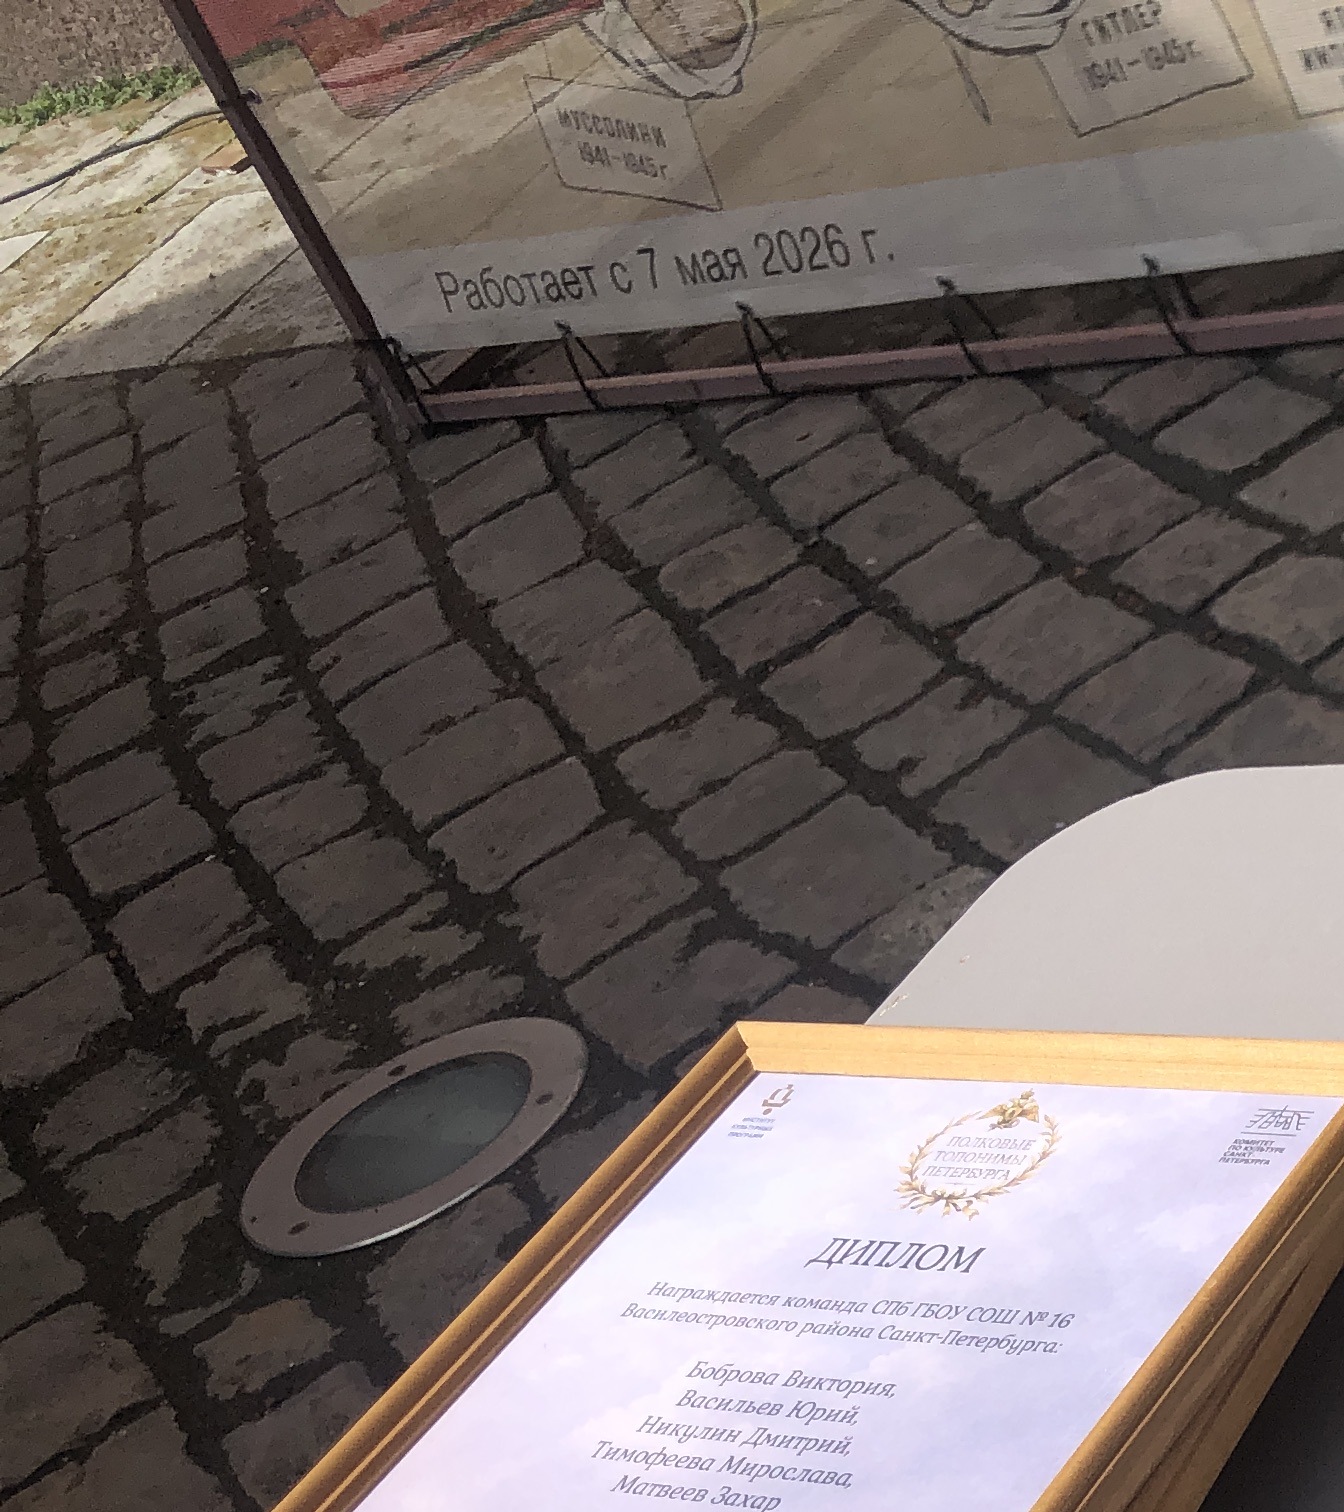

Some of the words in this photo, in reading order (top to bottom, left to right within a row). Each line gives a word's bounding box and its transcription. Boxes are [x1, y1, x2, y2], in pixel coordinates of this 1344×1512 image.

[434, 264, 599, 313] Работает
[609, 261, 633, 294] с
[636, 247, 658, 289] 7
[675, 246, 749, 287] мая
[754, 223, 851, 277] 2026
[860, 229, 895, 264] г.
[934, 1150, 1027, 1165] ТОПОНИМЫ
[946, 1136, 1036, 1150] ПОЛКОВЫЕ
[922, 1165, 1011, 1180] ПЕТЕРБУРГА
[805, 1237, 986, 1274] ДИПЛОМ
[647, 1281, 780, 1304] Награждается
[782, 1296, 868, 1314] команда
[872, 1300, 913, 1316] СПб
[911, 1302, 967, 1320] ГБОУ
[966, 1306, 1020, 1325] СОШ
[1019, 1310, 1049, 1326] №
[1048, 1313, 1075, 1328] 16
[620, 1302, 798, 1331] Василеостровского
[796, 1320, 875, 1338] района
[878, 1325, 1064, 1355] Санкт-Петербурга:
[685, 1361, 780, 1385] Боброва
[782, 1370, 897, 1399] Виктория,
[675, 1389, 783, 1417] Васильев
[786, 1401, 861, 1427] Юрий,
[636, 1415, 742, 1443] Никулин
[742, 1426, 853, 1457] Дмитрий,
[591, 1440, 716, 1472] Тимофеева
[716, 1455, 854, 1489] Мирослава,
[610, 1475, 709, 1503] Матвеев
